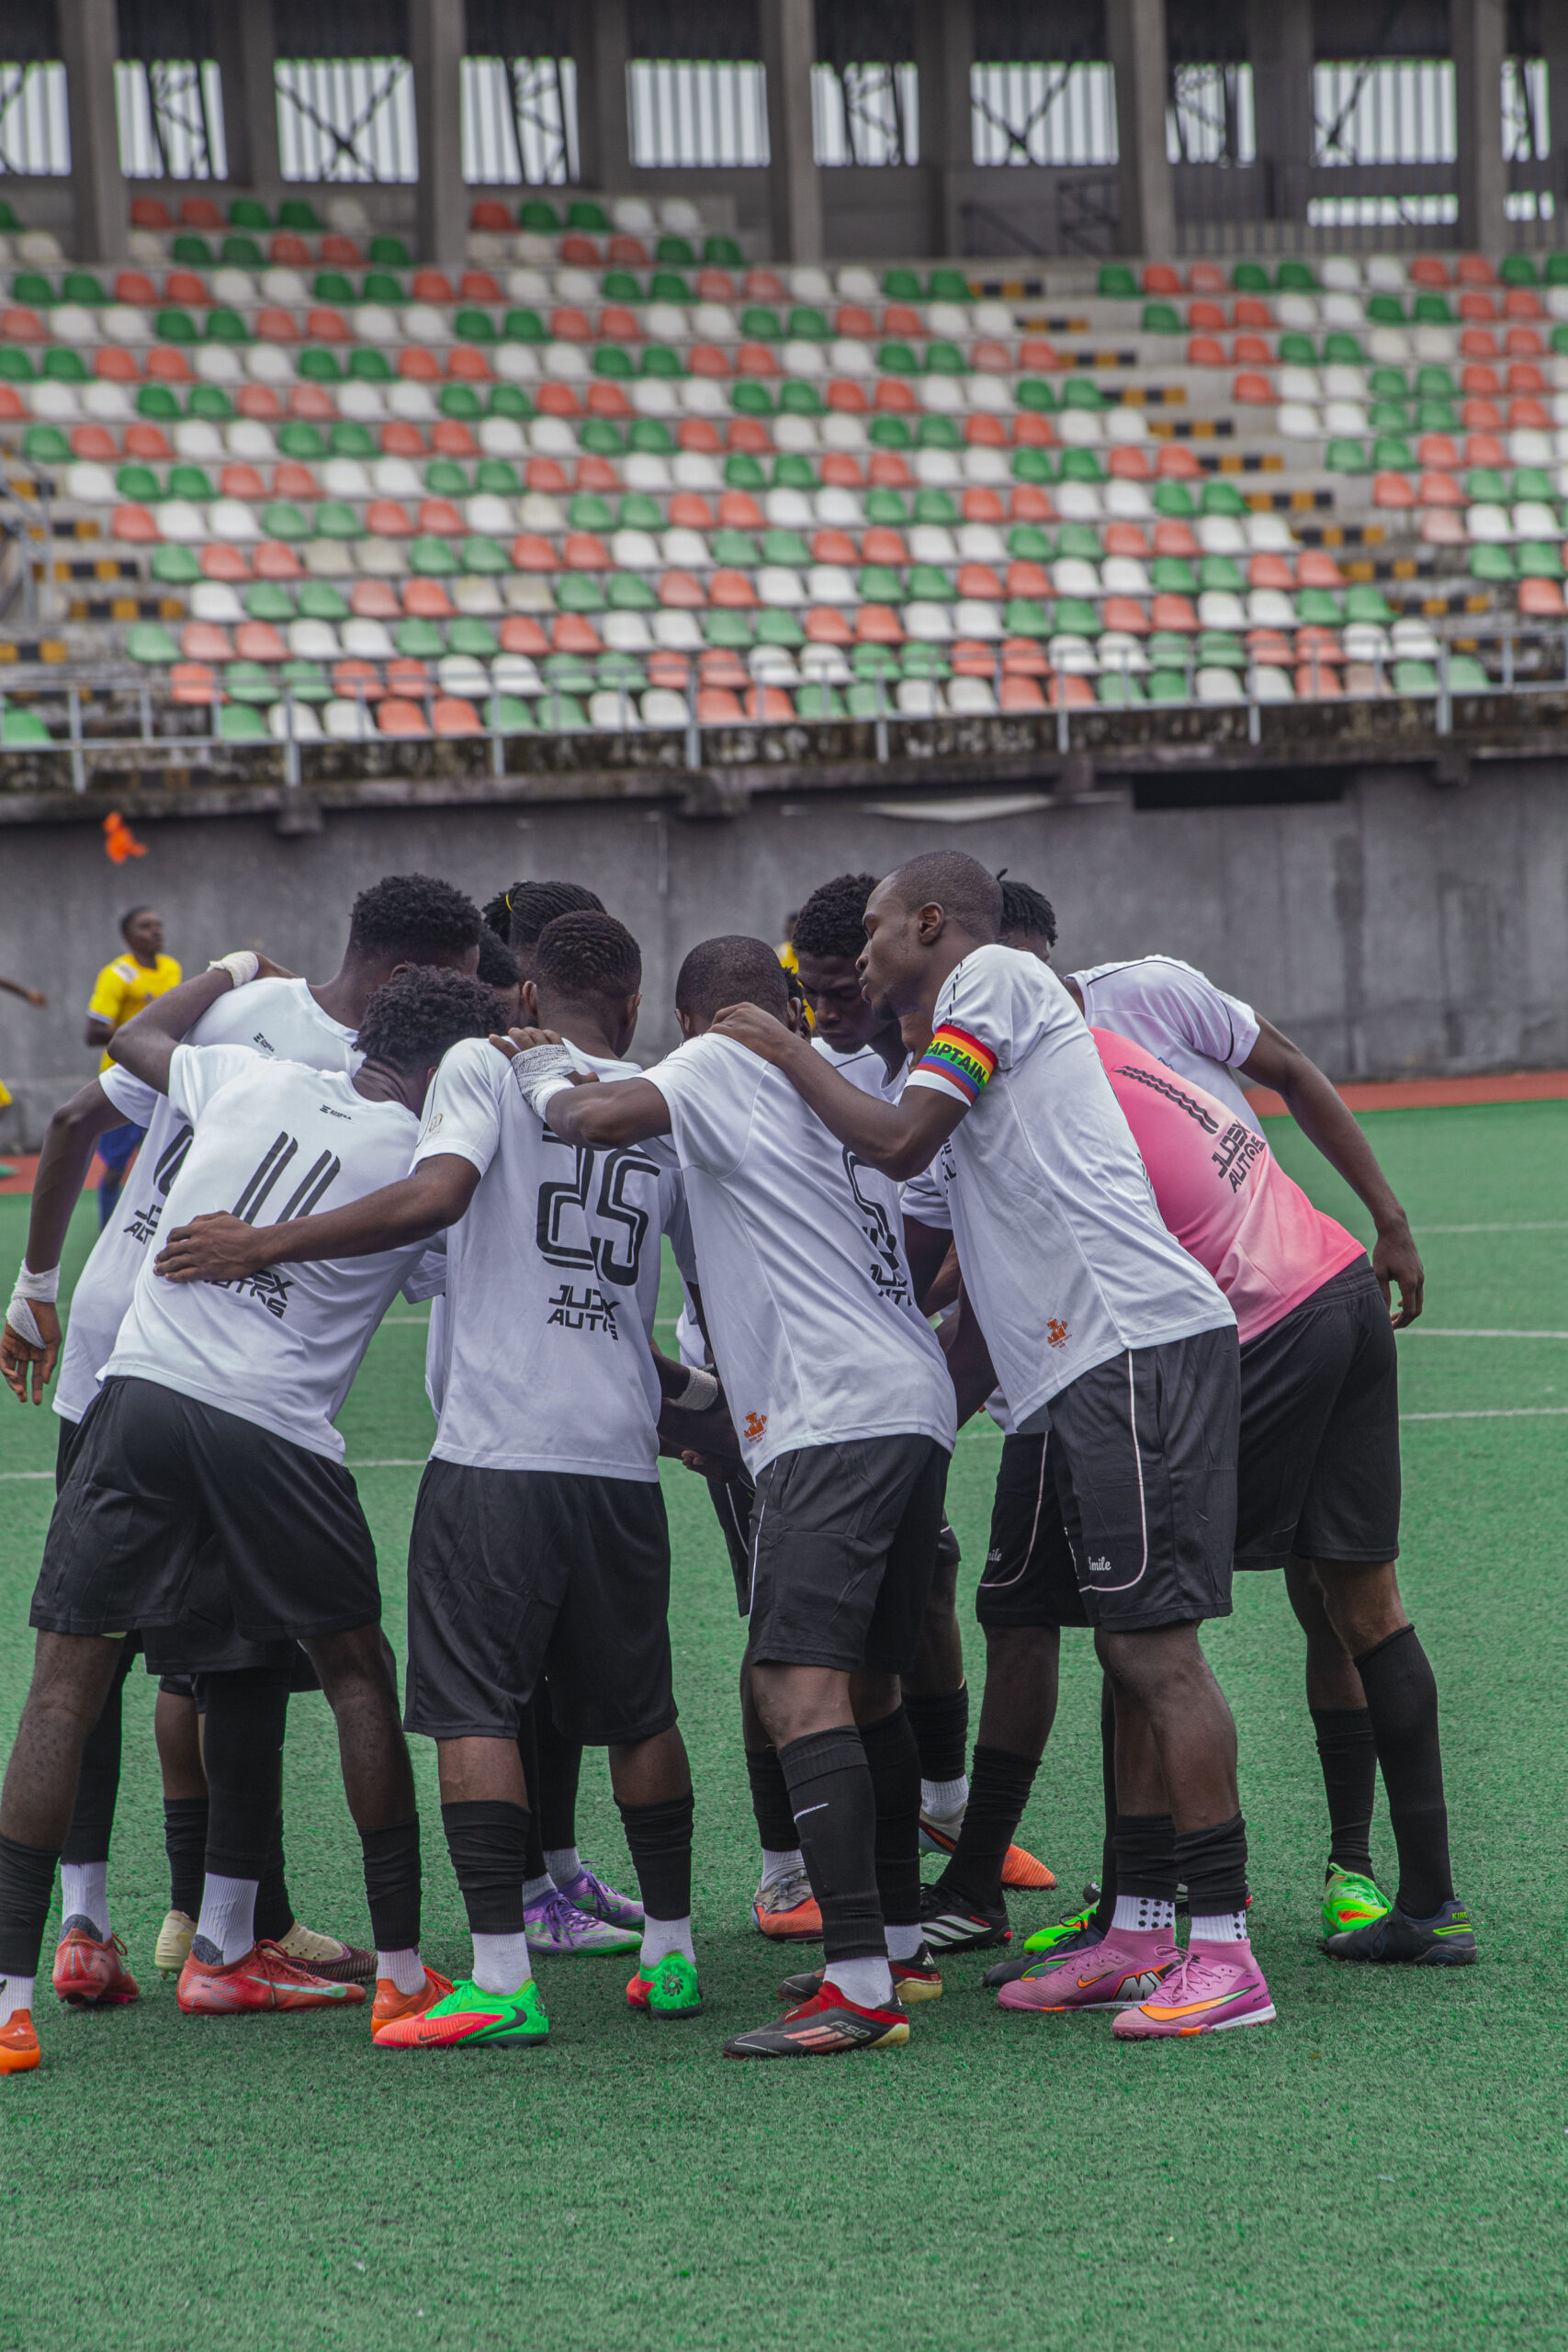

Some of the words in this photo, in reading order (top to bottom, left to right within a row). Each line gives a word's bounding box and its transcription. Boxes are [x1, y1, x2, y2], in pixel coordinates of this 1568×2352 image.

[1212, 1119, 1250, 1179] JUDEX
[1228, 1136, 1267, 1193] AUTOS
[536, 1121, 661, 1286] 25
[830, 2020, 872, 2040] F50
